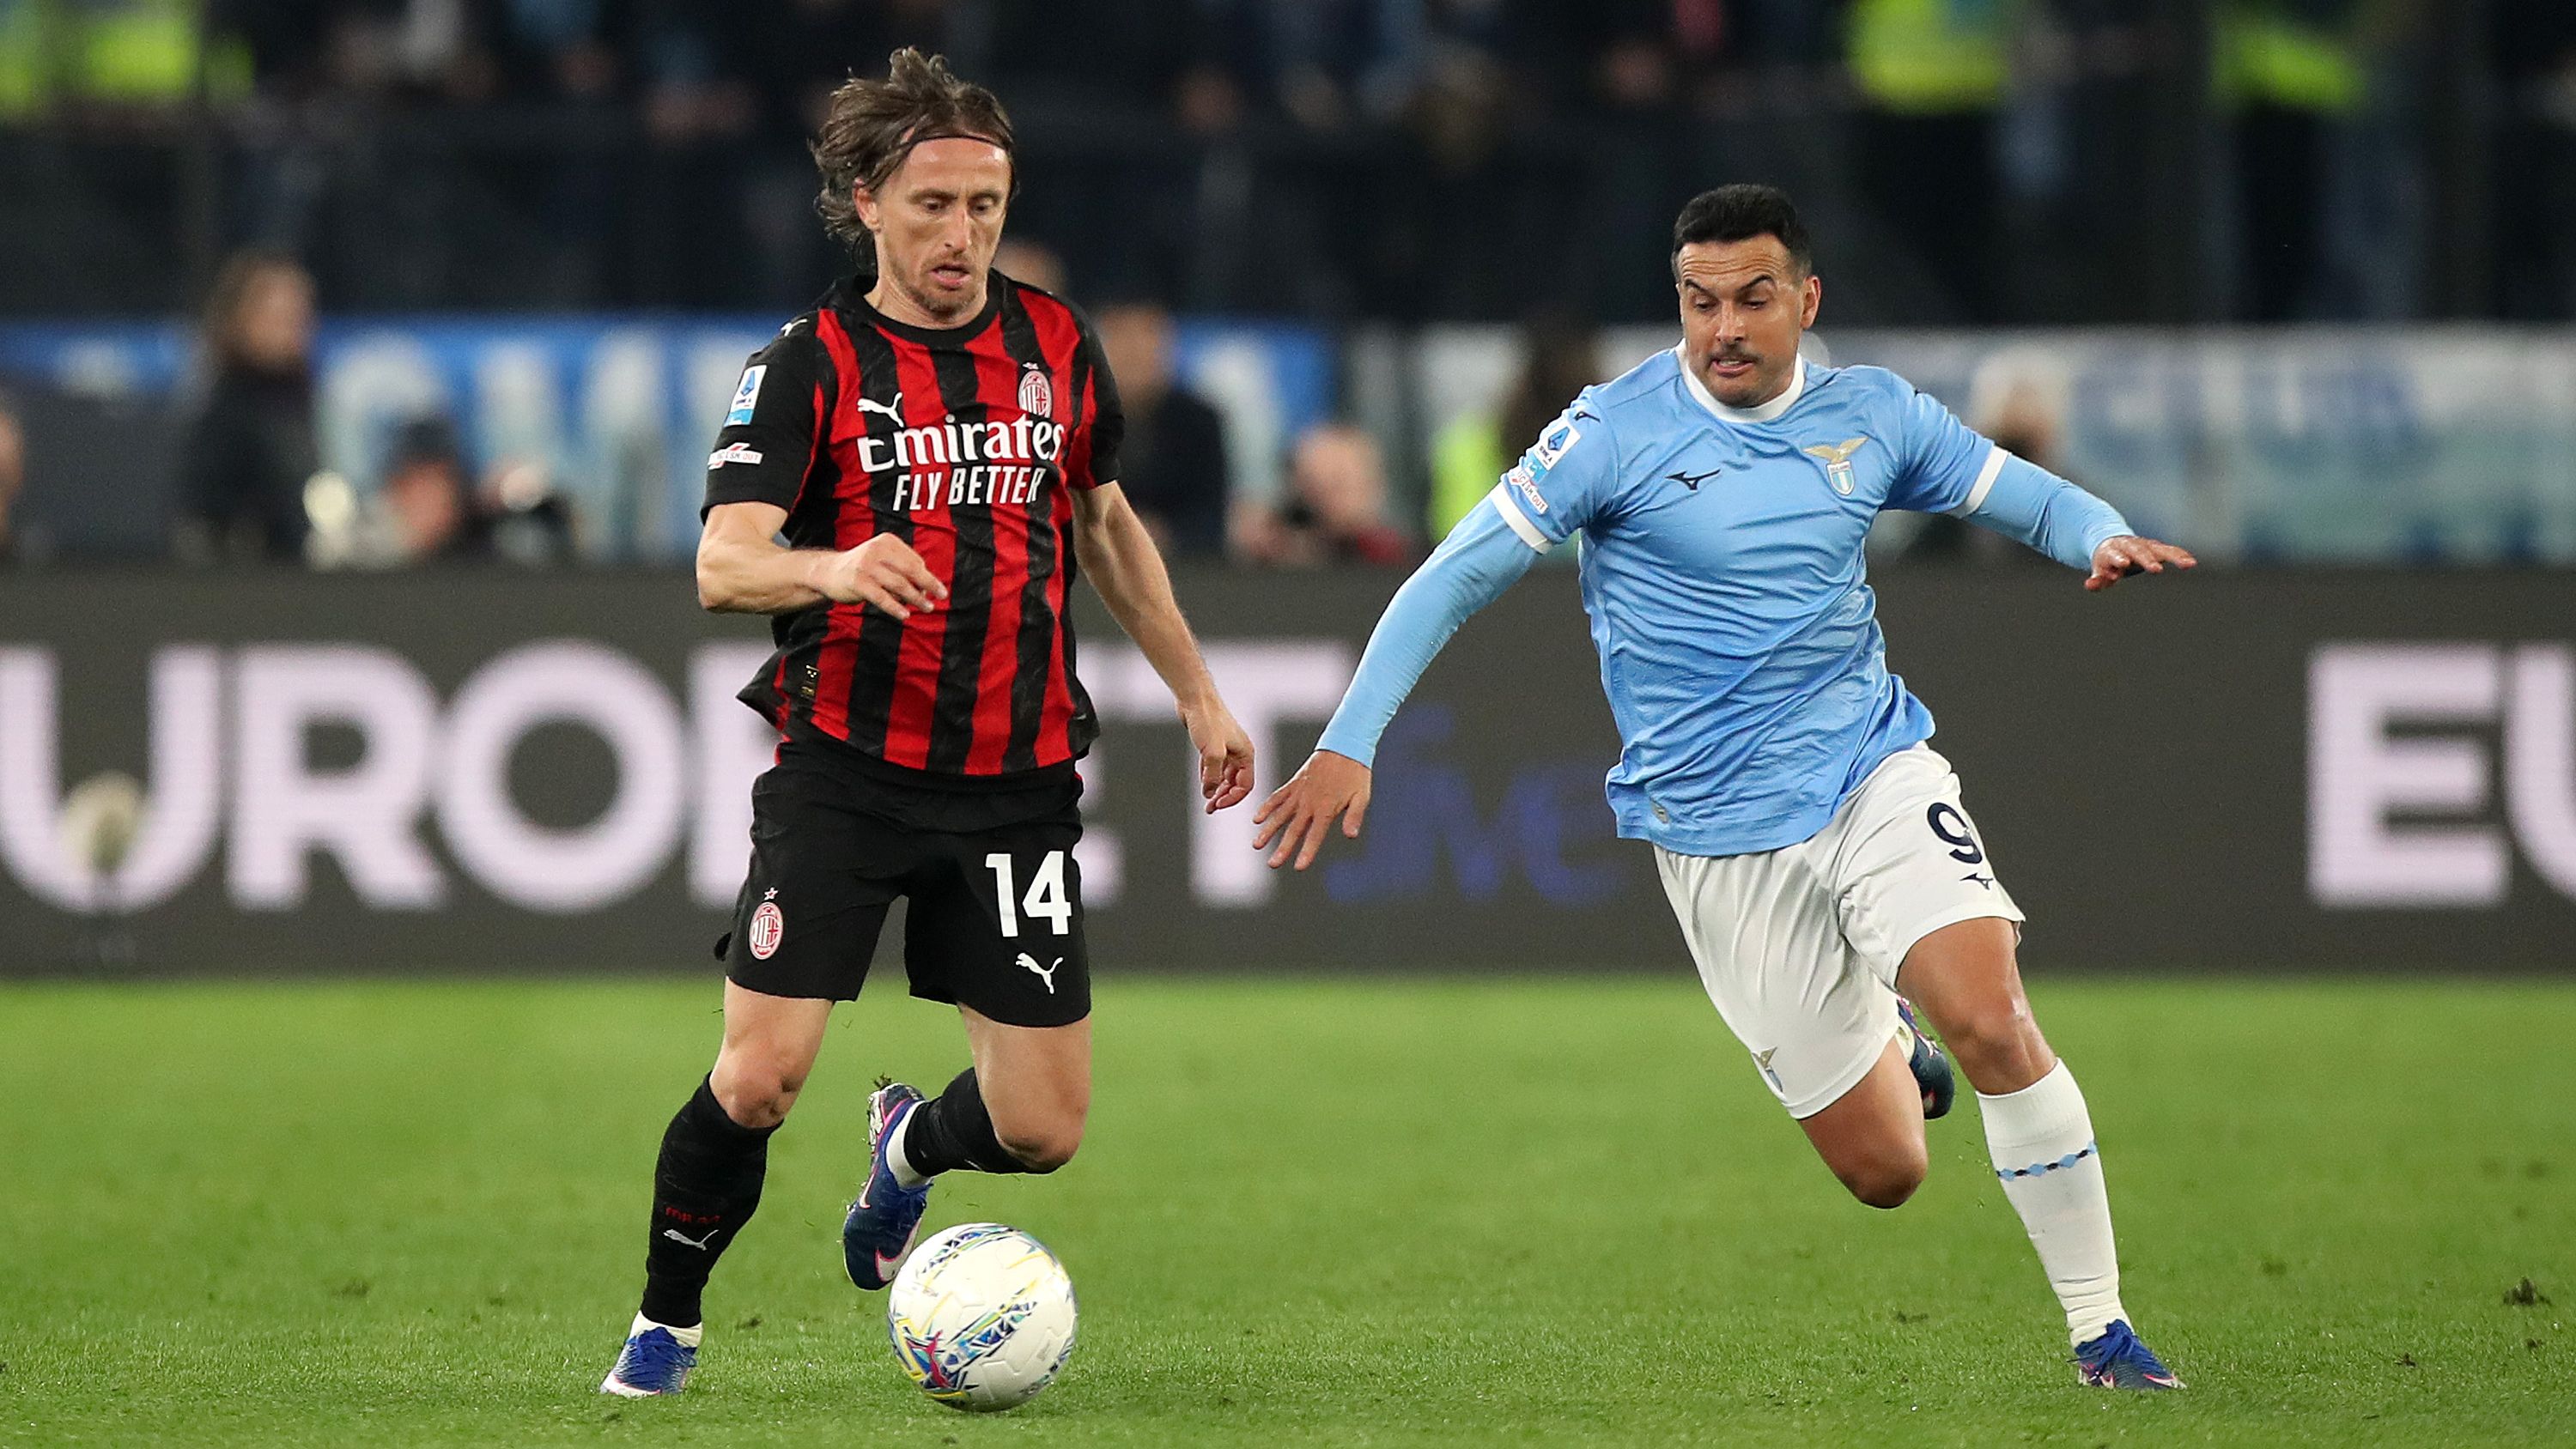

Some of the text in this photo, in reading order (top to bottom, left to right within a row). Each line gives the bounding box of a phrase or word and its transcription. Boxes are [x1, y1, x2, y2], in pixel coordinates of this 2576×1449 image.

[857, 413, 1065, 473] Emirates
[892, 465, 1047, 512] FLY BETTER
[1531, 494, 1546, 511] OUT
[1926, 802, 1983, 864] 9
[985, 850, 1072, 937] 14
